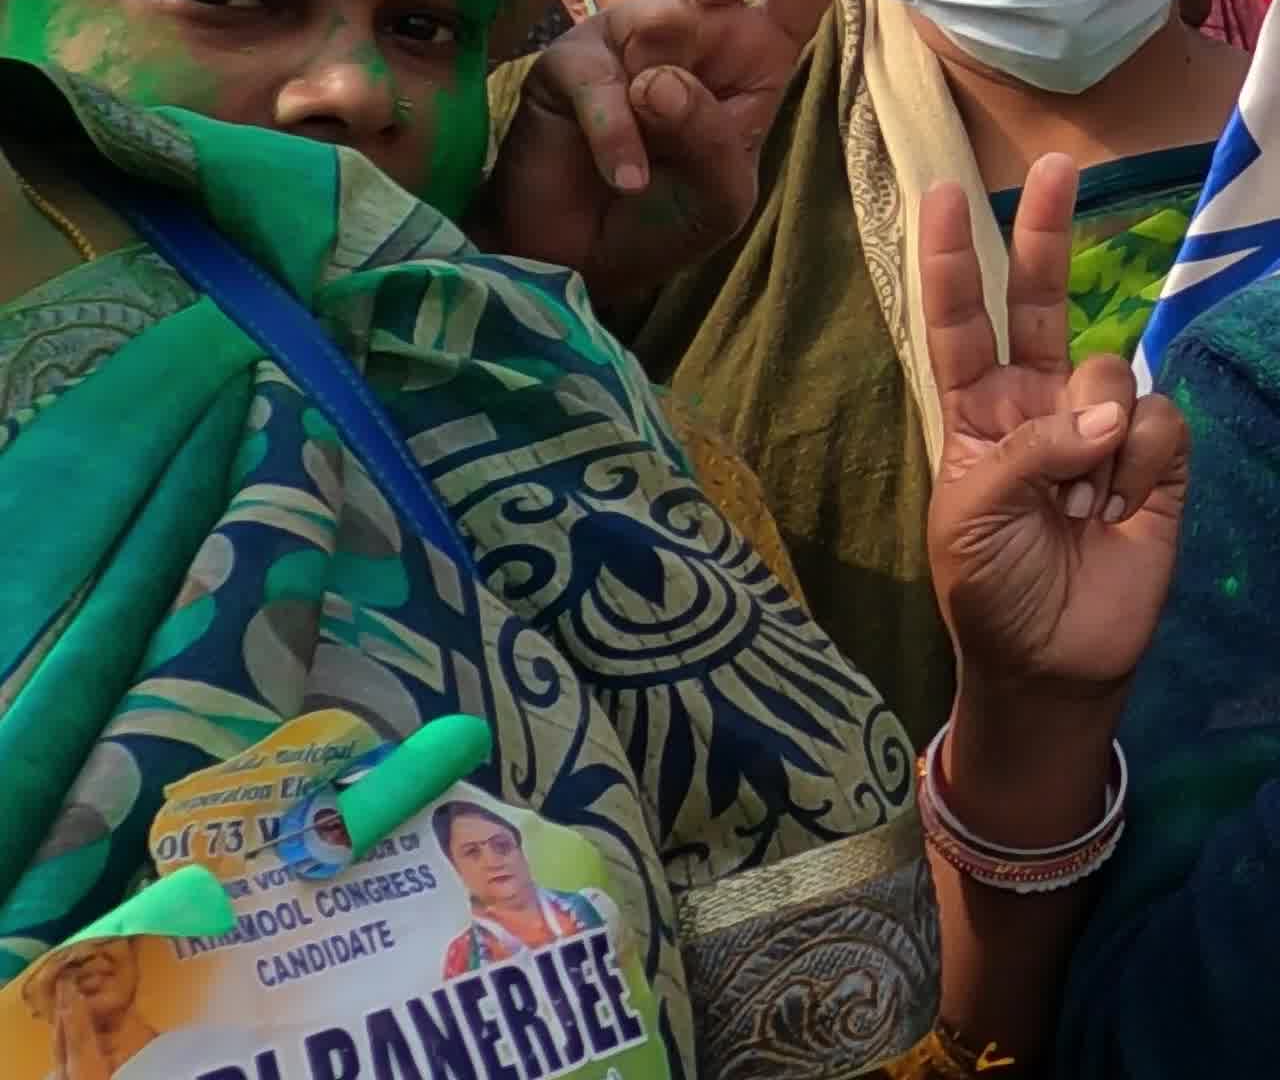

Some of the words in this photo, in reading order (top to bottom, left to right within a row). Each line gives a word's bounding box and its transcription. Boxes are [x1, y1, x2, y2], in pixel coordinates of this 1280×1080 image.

[157, 823, 194, 860] of
[206, 819, 245, 855] 73
[315, 863, 438, 918] CONGRESS
[256, 919, 396, 988] CANDIDATE
